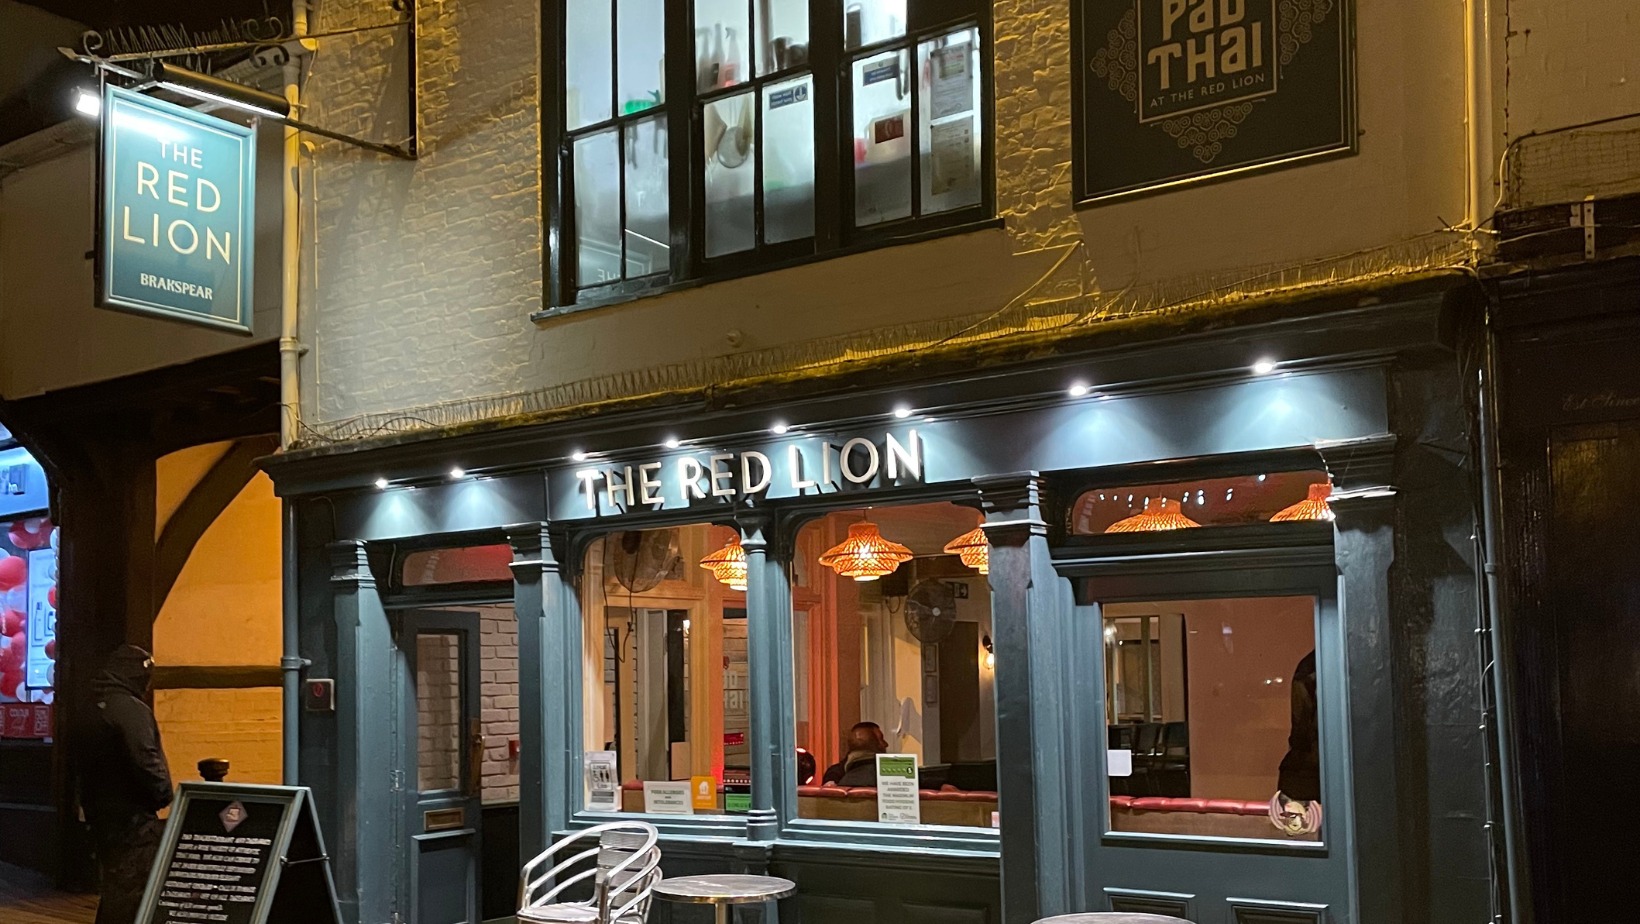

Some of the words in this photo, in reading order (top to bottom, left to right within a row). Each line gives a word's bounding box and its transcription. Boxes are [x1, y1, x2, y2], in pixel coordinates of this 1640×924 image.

[1150, 96, 1164, 108] AT
[1170, 89, 1193, 103] THE
[1201, 82, 1225, 96] RED
[1232, 73, 1265, 89] LION
[158, 139, 203, 169] THE
[137, 161, 221, 212] RED
[123, 206, 231, 265] LION
[140, 272, 213, 301] BRAKSPEAR
[575, 462, 665, 510] THE
[677, 450, 771, 500] RED
[788, 429, 922, 490] LION
